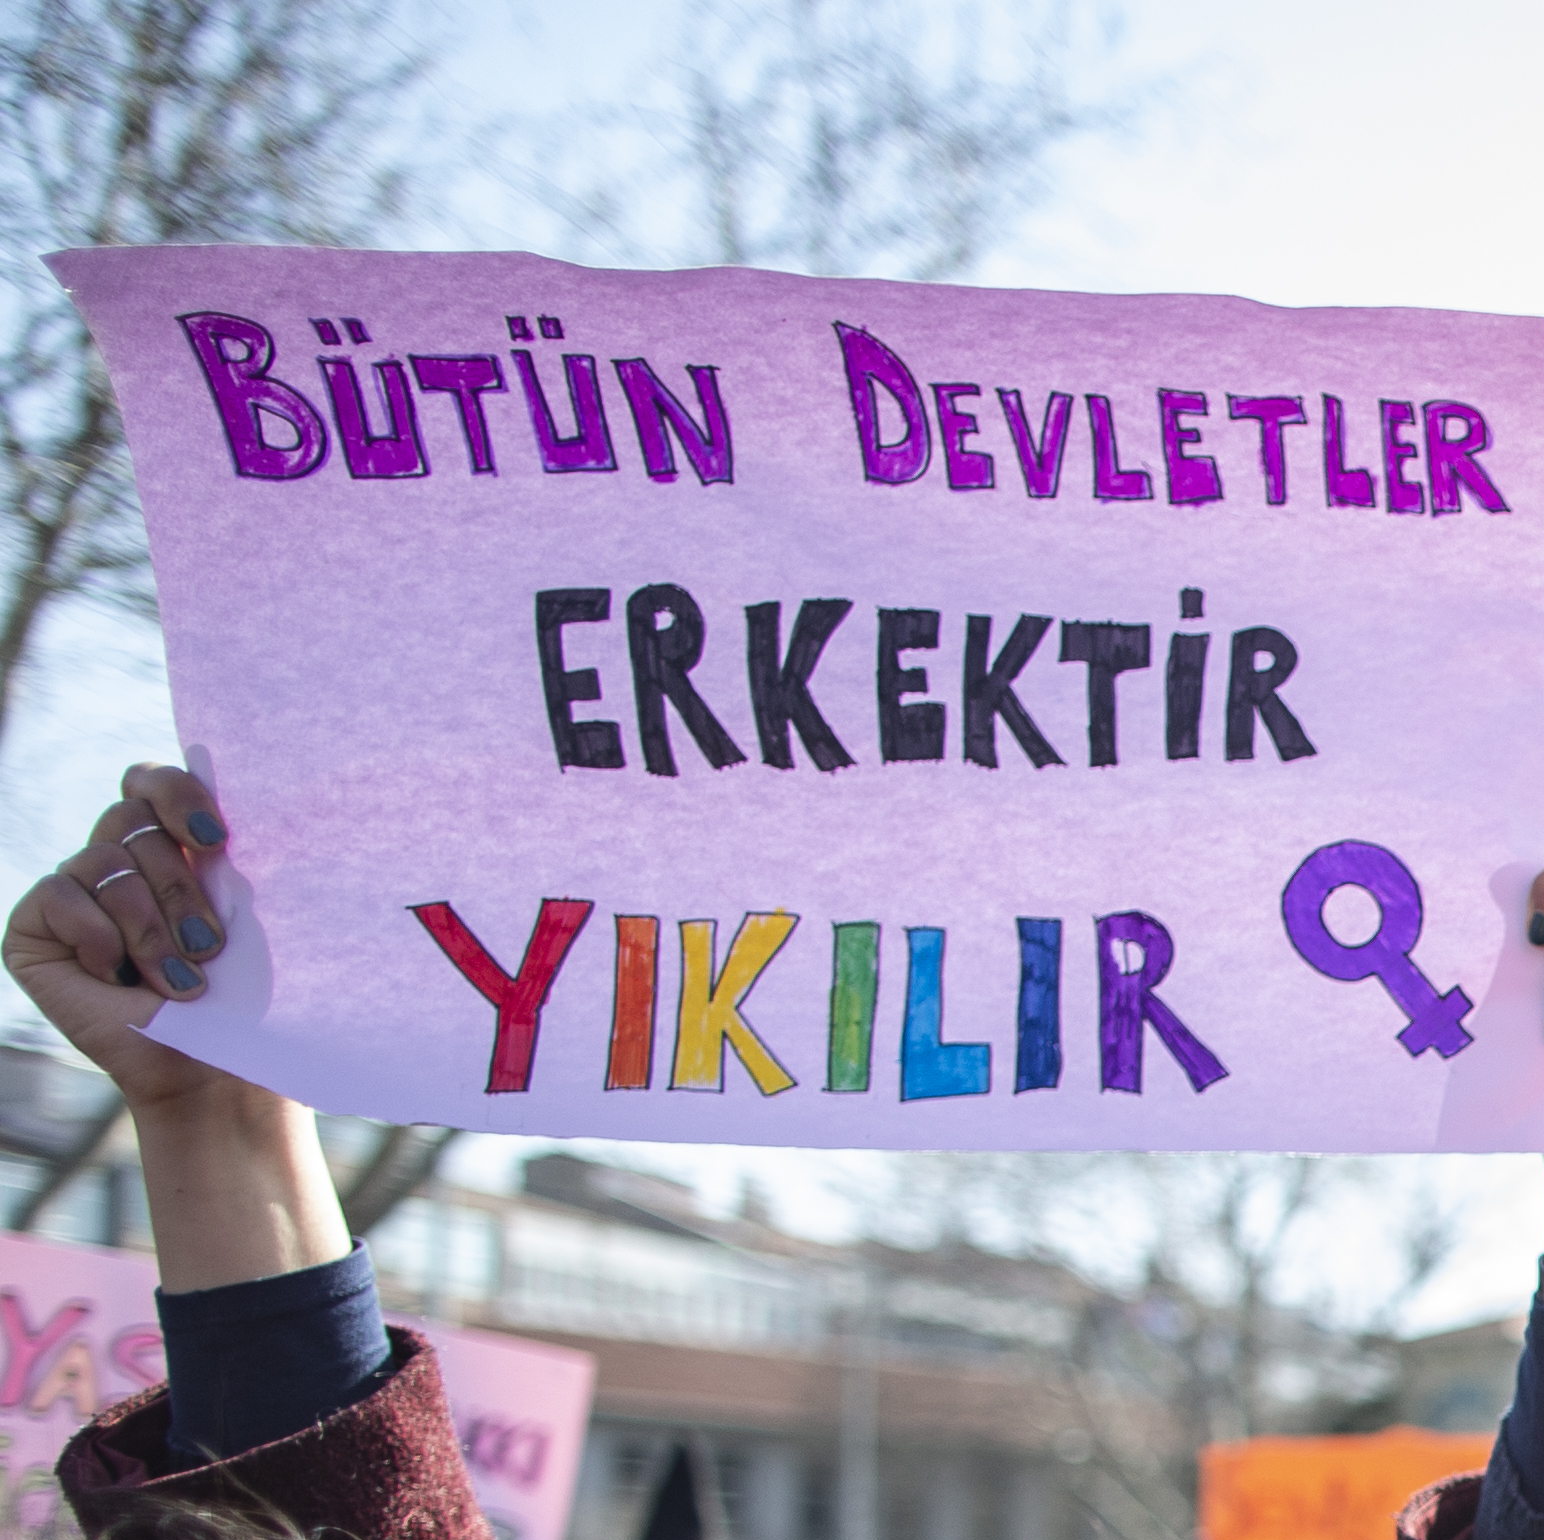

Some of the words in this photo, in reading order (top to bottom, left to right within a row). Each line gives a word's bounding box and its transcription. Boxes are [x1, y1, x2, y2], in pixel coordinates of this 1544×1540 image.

[176, 310, 734, 486] BÜTÜN
[833, 321, 1509, 517] DEVLETLER
[535, 582, 1318, 776] ERKEKTİR
[408, 896, 1229, 1102] YIKILIR
